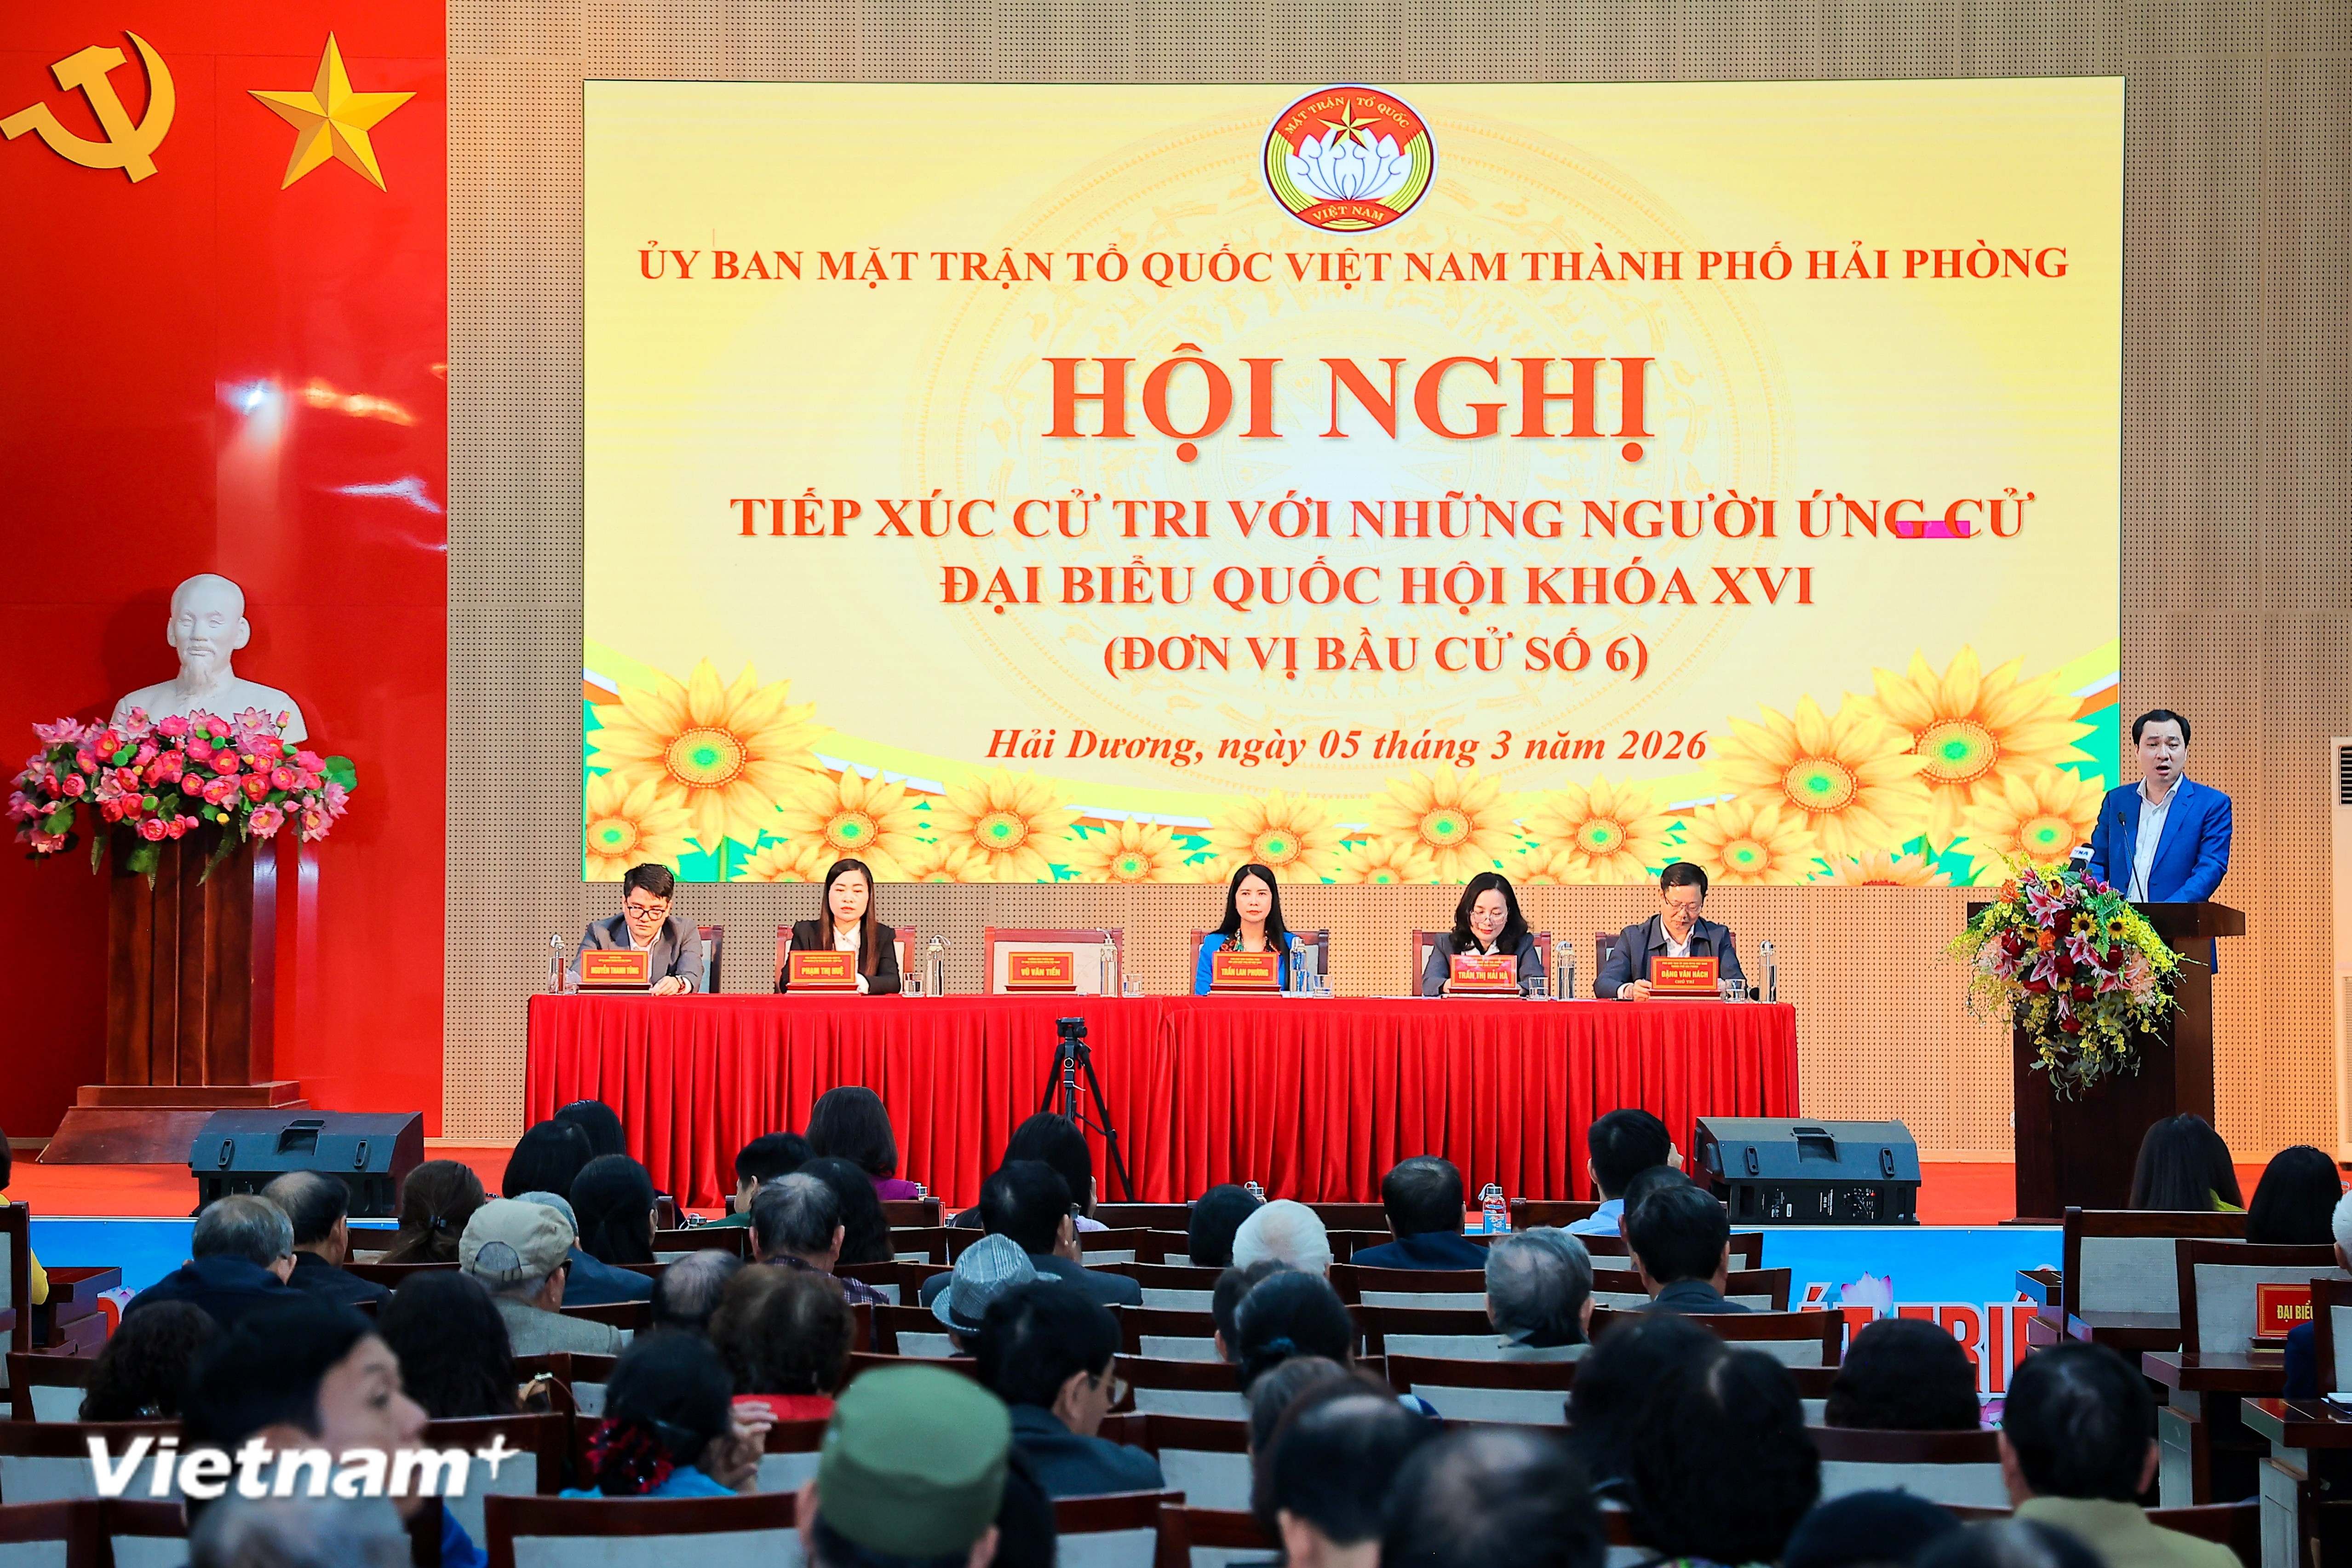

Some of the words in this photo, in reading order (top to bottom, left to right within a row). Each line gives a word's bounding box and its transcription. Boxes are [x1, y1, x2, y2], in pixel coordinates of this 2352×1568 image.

[1285, 108, 1308, 135] MẶT
[1308, 97, 1346, 115] TRẬN
[1356, 95, 1375, 109] TỔ
[1376, 103, 1411, 129] QUỐC
[1312, 205, 1348, 221] VIỆT
[1351, 206, 1385, 222] NAM
[639, 241, 700, 279] ỦY
[712, 251, 803, 280] BAN
[818, 247, 918, 288] MẶT
[931, 247, 1053, 289] TRẬN
[1067, 244, 1128, 281] TỔ
[1142, 244, 1271, 287] QUỐC
[1285, 248, 1391, 290] VIỆT
[1405, 253, 1507, 281] NAM
[1522, 243, 1682, 280] THÀNH
[1698, 241, 1792, 280] PHỐ
[1807, 241, 1888, 279] HẢI
[1904, 240, 2068, 278] PHÒNG
[1042, 343, 1283, 462] HỘI
[1319, 356, 1655, 462] NGHỊ
[730, 488, 860, 536] TIẾP
[875, 489, 994, 537] XÚC
[1014, 489, 1101, 537] CỬ
[1113, 501, 1209, 537] TRI
[1228, 490, 1330, 537] VỚI
[1350, 491, 1562, 538] NHỮNG
[1582, 490, 1776, 538] NGƯỜI
[1796, 489, 1928, 538] ỨNG
[1945, 488, 2035, 538] CỬ
[940, 567, 1040, 615] ĐẠI
[1061, 556, 1194, 604] BIỂU
[1213, 556, 1379, 611] QUỐC
[1401, 561, 1505, 615] HỘI
[1526, 557, 1697, 604] KHÓA
[1711, 568, 1813, 604] XVI
[1105, 634, 1230, 679] (ĐƠN
[1246, 638, 1298, 680] VỊ
[1316, 626, 1418, 671] BẦU
[1435, 626, 1513, 671] CỬ
[1526, 626, 1590, 671] SỐ
[1606, 634, 1647, 680] 6)
[986, 729, 1056, 758] Hải
[1066, 730, 1203, 766] Dương,
[1218, 729, 1306, 767] ngày
[1320, 730, 1361, 758] 05
[1374, 729, 1479, 767] tháng
[1491, 730, 1511, 759] 3
[1525, 731, 1605, 759] năm
[1618, 731, 1706, 759] 2026
[801, 967, 820, 976] PHẠM
[820, 967, 831, 976] THỊ
[1476, 971, 1486, 981] THỊ
[1487, 969, 1497, 979] HẢI
[2277, 1305, 2293, 1322] ĐẠI
